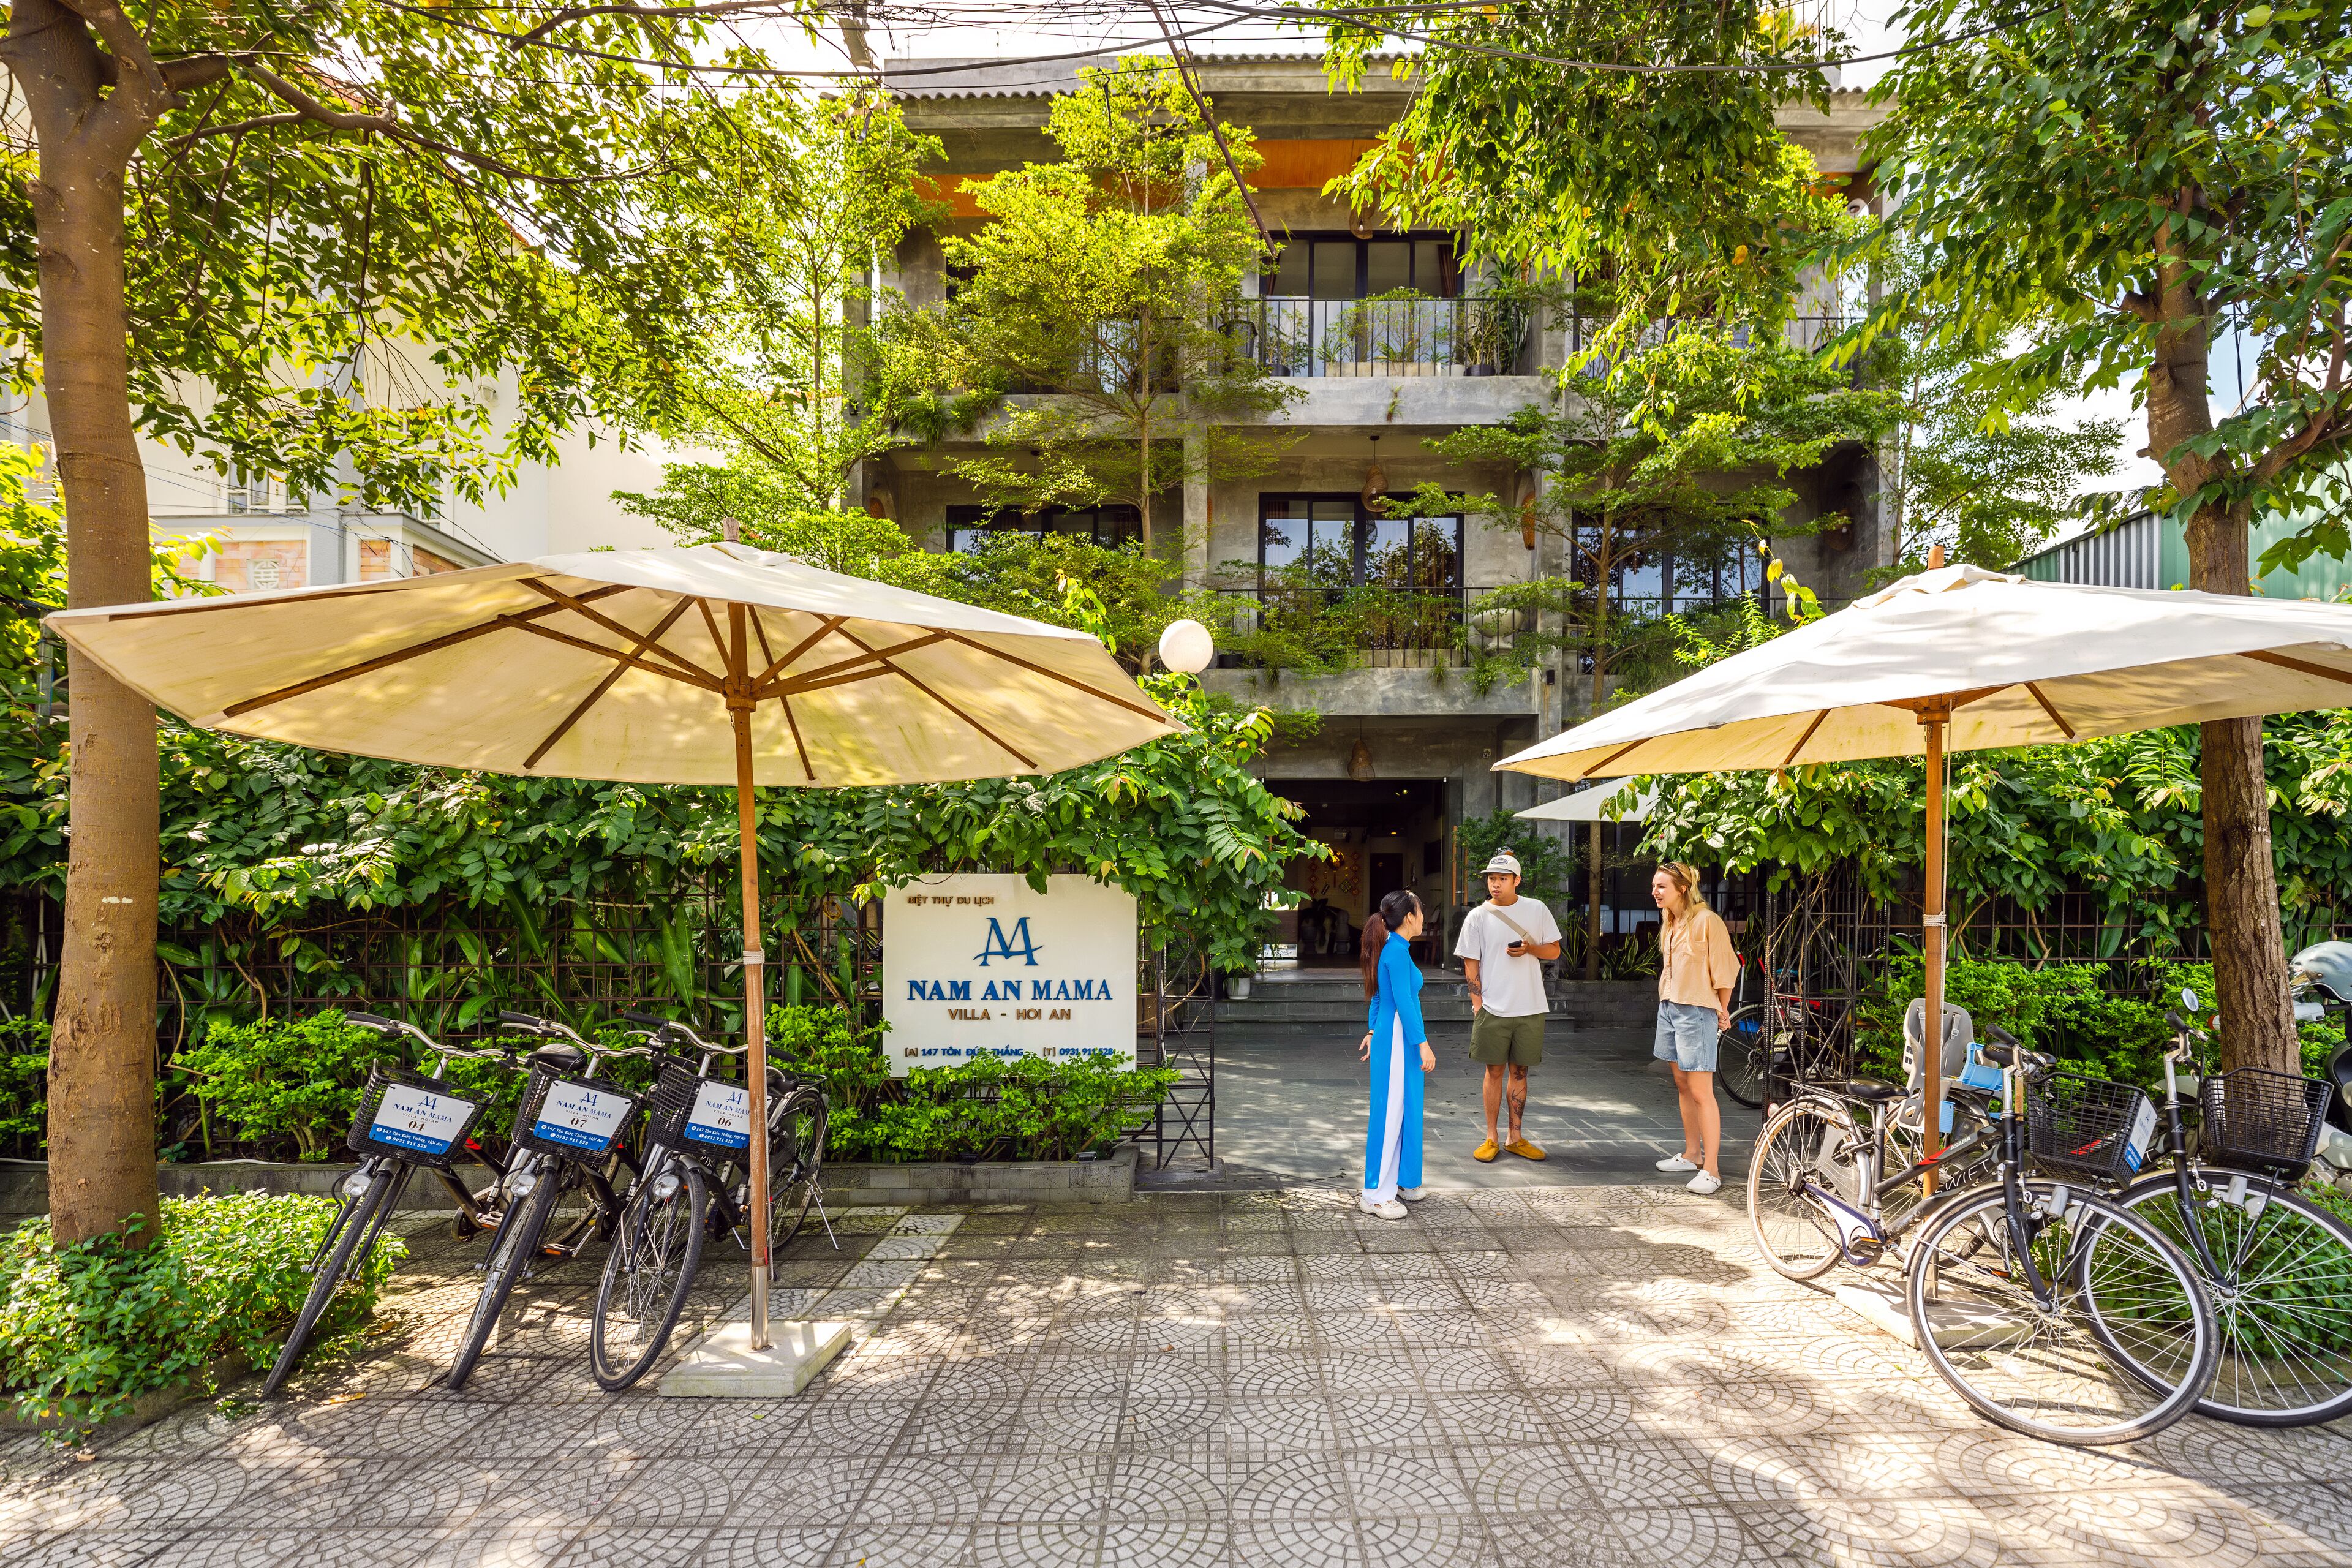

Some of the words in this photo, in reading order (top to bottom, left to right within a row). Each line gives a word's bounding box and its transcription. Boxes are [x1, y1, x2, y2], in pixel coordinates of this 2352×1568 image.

[907, 894, 928, 907] BIỆT
[932, 896, 953, 907] THỰ
[974, 897, 995, 907] LỊCH
[907, 980, 972, 1000] NAM
[981, 979, 1022, 1000] AN
[1031, 979, 1114, 1000] MAMA
[948, 1009, 991, 1020] VILLA
[1016, 1008, 1042, 1020] HOI
[1049, 1008, 1071, 1020] AN
[921, 1048, 938, 1057] 147
[941, 1046, 962, 1057] TÔN
[991, 1044, 1024, 1057] THẮNG
[1059, 1048, 1079, 1057] 0931
[1082, 1048, 1096, 1057] 911
[557, 1100, 575, 1109] NAM
[590, 1109, 612, 1118] MAMA
[705, 1101, 722, 1109] NAM
[393, 1103, 413, 1112] NAM
[429, 1112, 452, 1123] MAMA
[408, 1121, 424, 1131] 04
[570, 1117, 588, 1128] 07
[718, 1117, 733, 1127] 06
[1950, 1136, 1971, 1150] ASAMA
[1934, 1158, 1990, 1194] SWIFT
